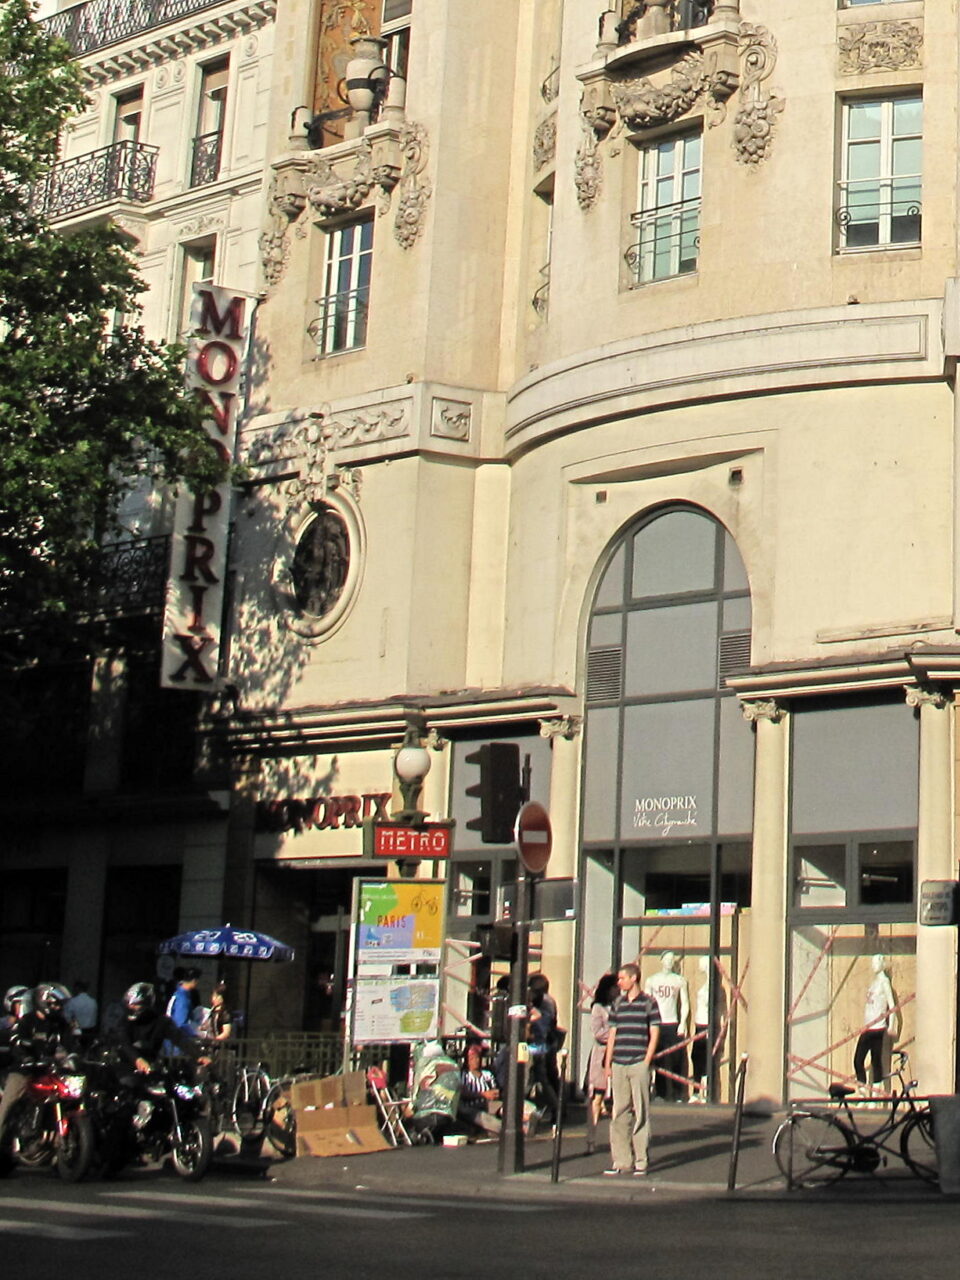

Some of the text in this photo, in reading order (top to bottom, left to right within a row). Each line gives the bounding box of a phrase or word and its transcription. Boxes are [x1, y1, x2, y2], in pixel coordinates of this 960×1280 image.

[635, 795, 697, 812] MONOPRIX
[381, 831, 445, 851] METRO
[376, 914, 407, 928] PARIS
